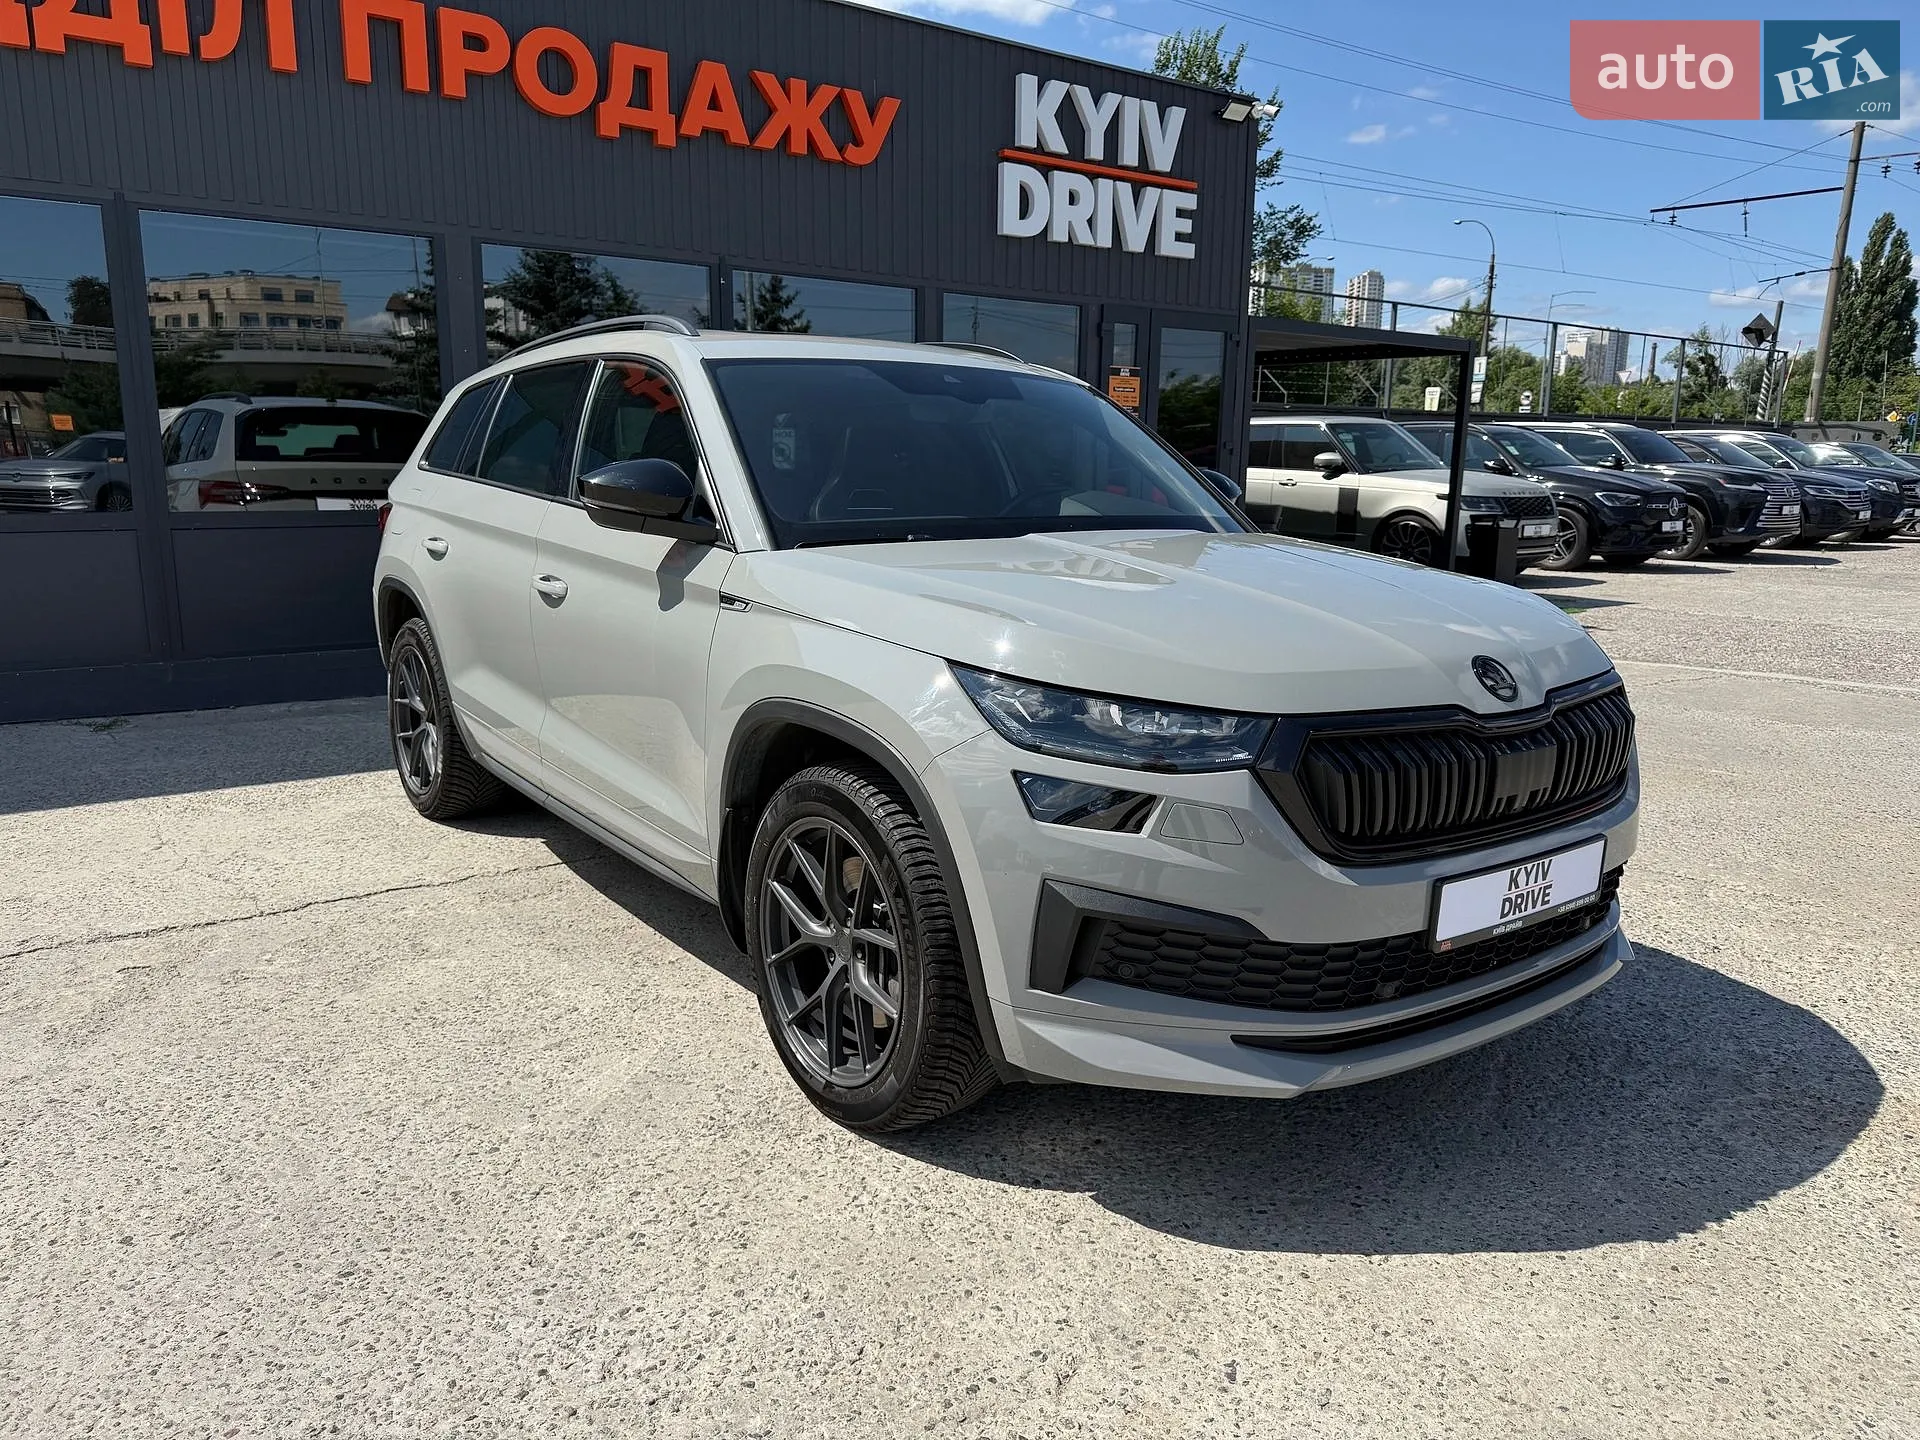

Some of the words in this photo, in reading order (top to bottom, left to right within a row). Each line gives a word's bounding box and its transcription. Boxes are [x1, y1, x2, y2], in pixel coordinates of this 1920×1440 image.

[340, 0, 902, 166] ПРОДАЖУ
[1015, 72, 1187, 173] KYIV
[997, 161, 1198, 259] DRIVE
[1500, 884, 1552, 919] DRIVE
[1508, 859, 1552, 891] KYIV
